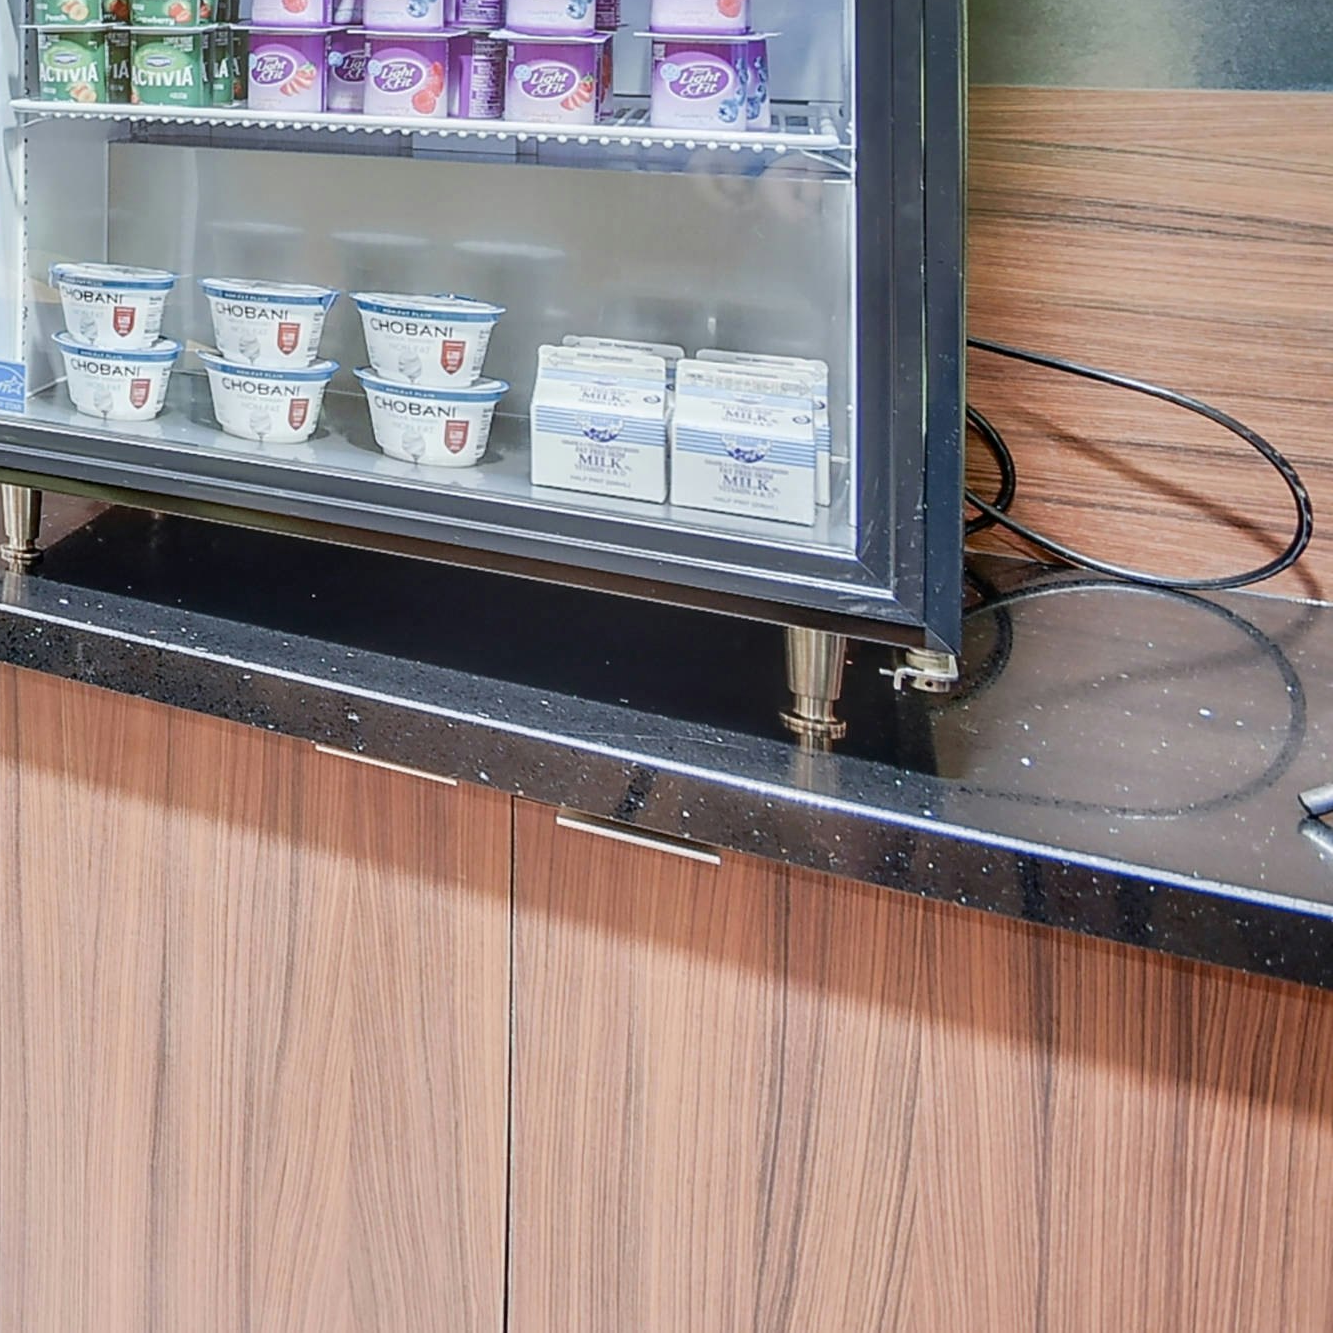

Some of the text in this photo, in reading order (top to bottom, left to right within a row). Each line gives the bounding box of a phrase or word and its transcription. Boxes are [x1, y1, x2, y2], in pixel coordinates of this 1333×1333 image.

[40, 63, 98, 83] ACTIVIA
[256, 59, 287, 74] Light
[381, 65, 415, 82] Light
[131, 65, 194, 87] ACTIVIA
[531, 71, 569, 86] Light
[680, 69, 721, 85] Light
[61, 285, 123, 304] CHOBANI
[215, 301, 288, 320] CHOBANI
[370, 317, 453, 338] CHOBANI
[71, 357, 141, 377] CHOBANI
[222, 377, 302, 396] CHOBANI
[582, 391, 622, 403] MILK
[374, 395, 457, 418] CHOBANI
[724, 408, 768, 423] MILK
[578, 453, 622, 469] MILK
[723, 474, 769, 491] MILK
